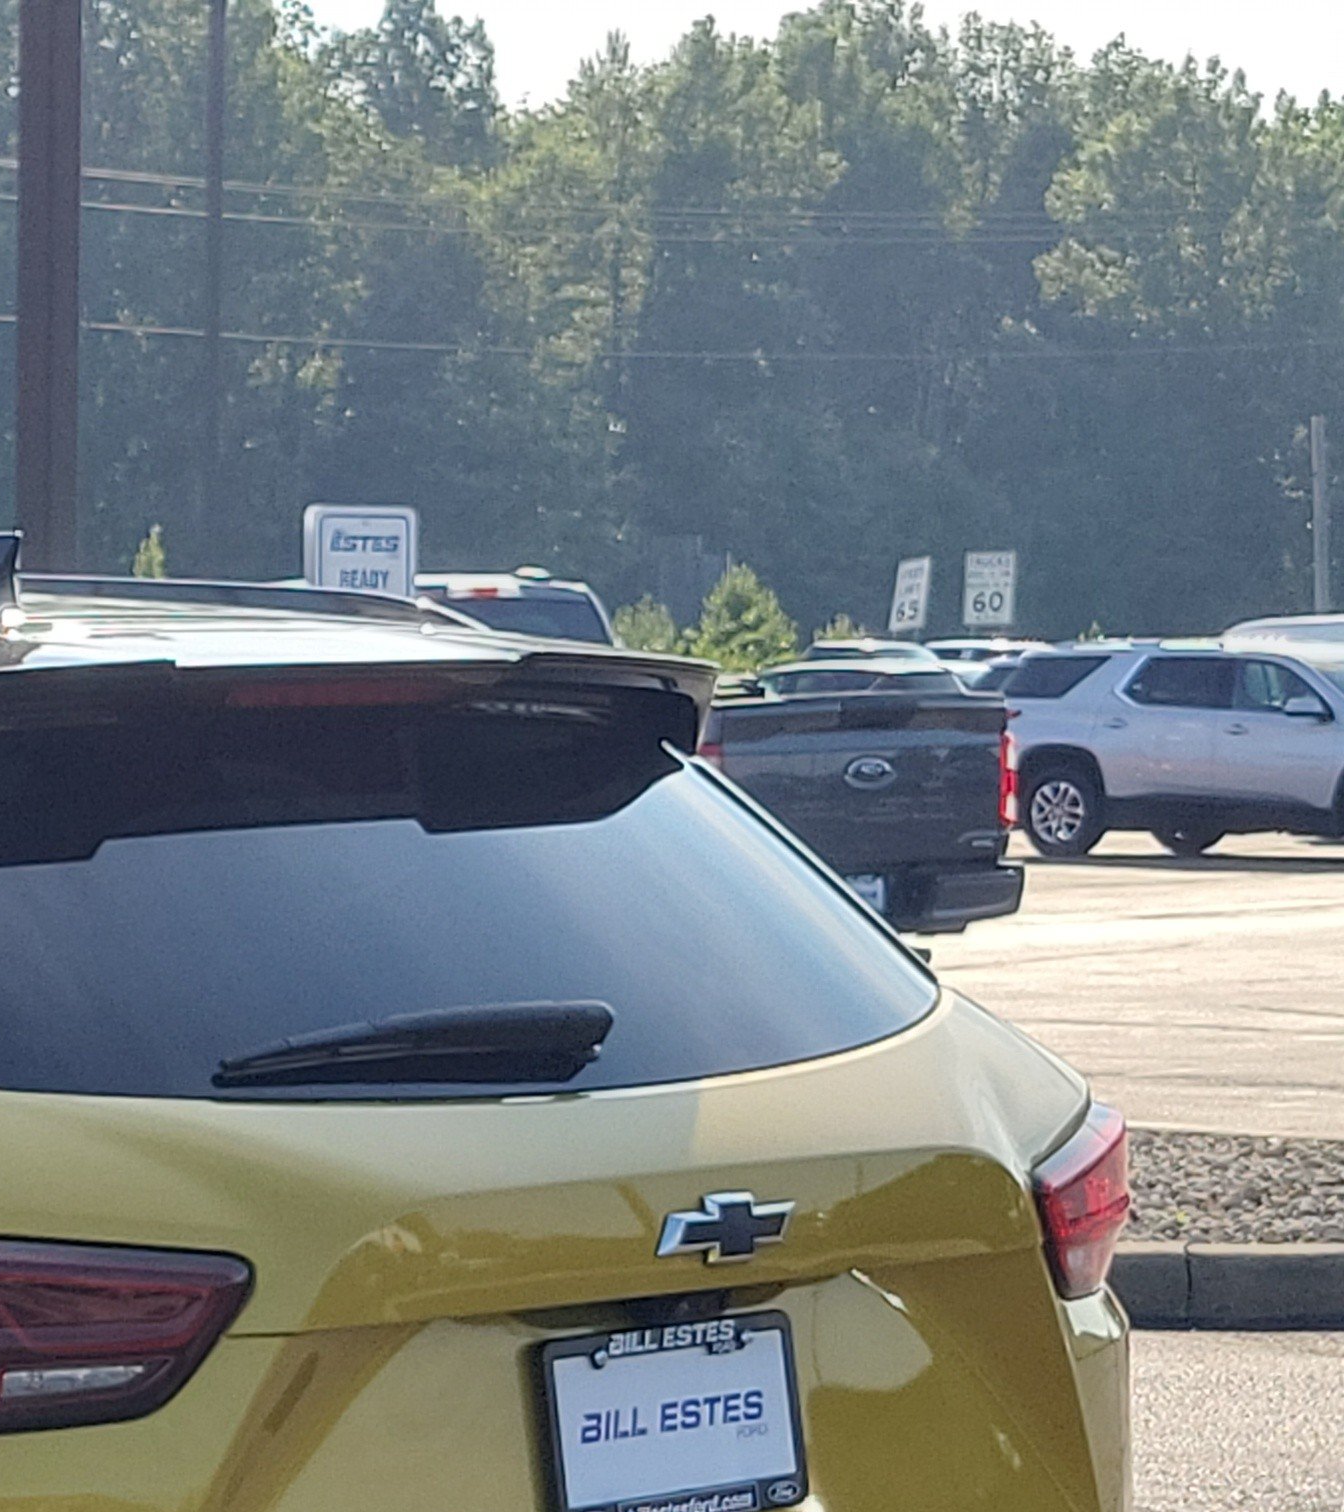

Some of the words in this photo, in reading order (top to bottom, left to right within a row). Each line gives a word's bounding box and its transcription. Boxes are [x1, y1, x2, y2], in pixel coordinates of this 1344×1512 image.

[339, 567, 390, 590] READY
[896, 600, 919, 623] 65
[973, 591, 1004, 613] 60
[608, 1328, 659, 1356] BILL
[662, 1319, 736, 1348] ESTES
[580, 1406, 648, 1444] BILL
[660, 1389, 764, 1432] ESTES
